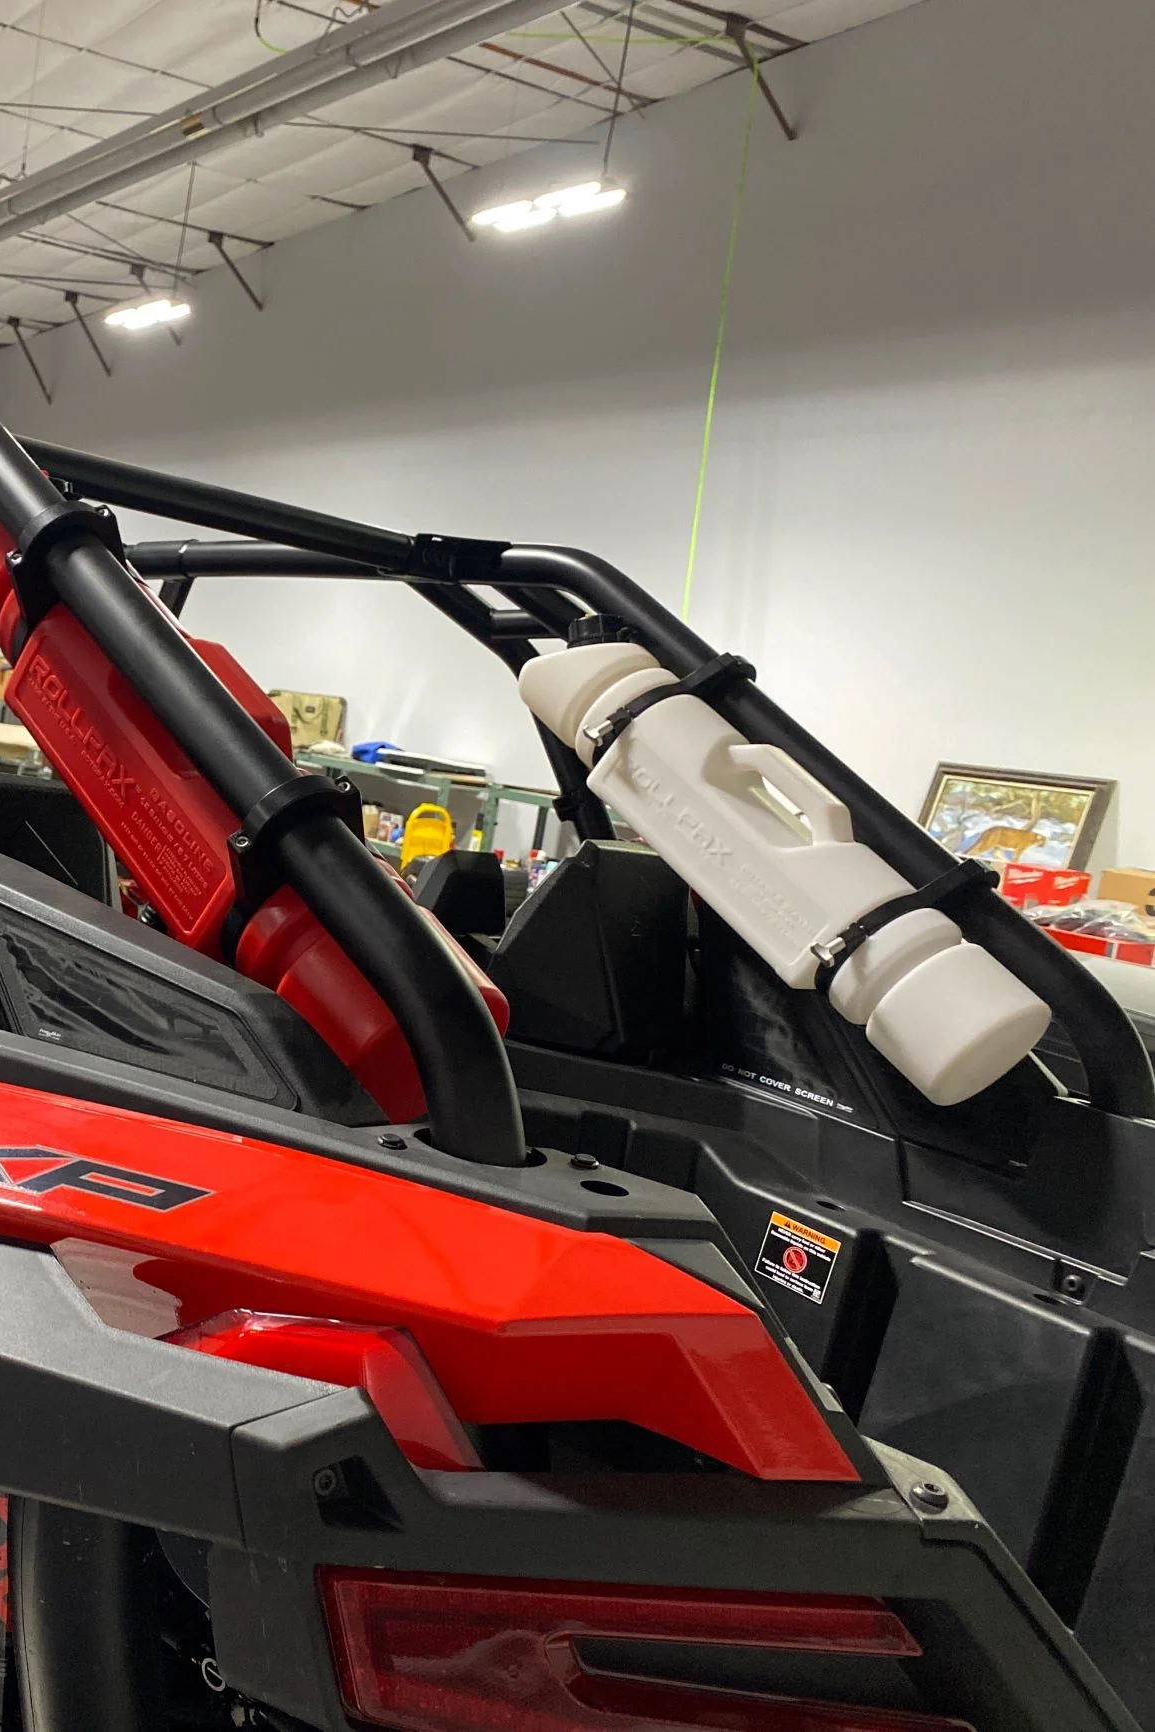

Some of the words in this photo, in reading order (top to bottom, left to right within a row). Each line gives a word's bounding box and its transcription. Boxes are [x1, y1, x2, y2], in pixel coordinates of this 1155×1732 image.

[737, 1068, 757, 1080] NOT
[759, 1076, 791, 1092] COVER
[794, 1088, 834, 1107] SCREEN
[792, 1224, 826, 1244] WARNING
